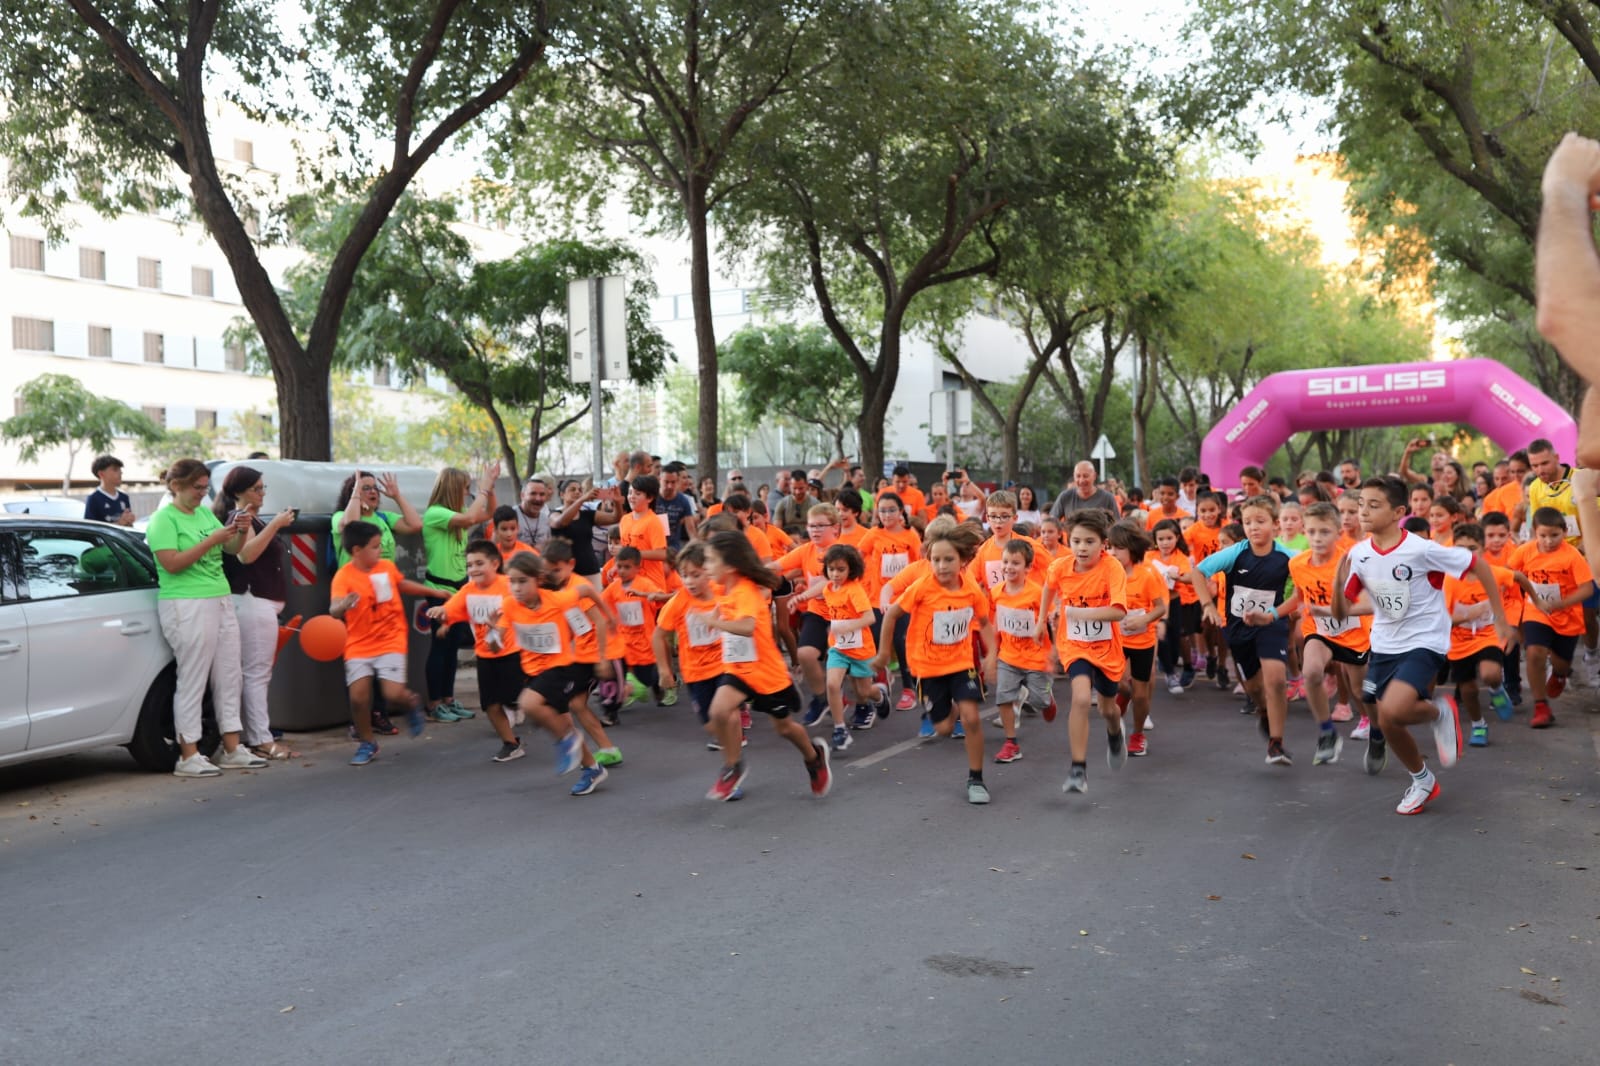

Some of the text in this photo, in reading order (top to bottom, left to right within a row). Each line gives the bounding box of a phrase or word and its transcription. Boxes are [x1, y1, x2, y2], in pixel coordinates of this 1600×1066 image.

[1308, 369, 1446, 396] SOLISS
[1490, 383, 1542, 426] SOLISS
[1225, 399, 1269, 443] SOLISS
[941, 620, 968, 638] 300
[1073, 620, 1102, 636] 319
